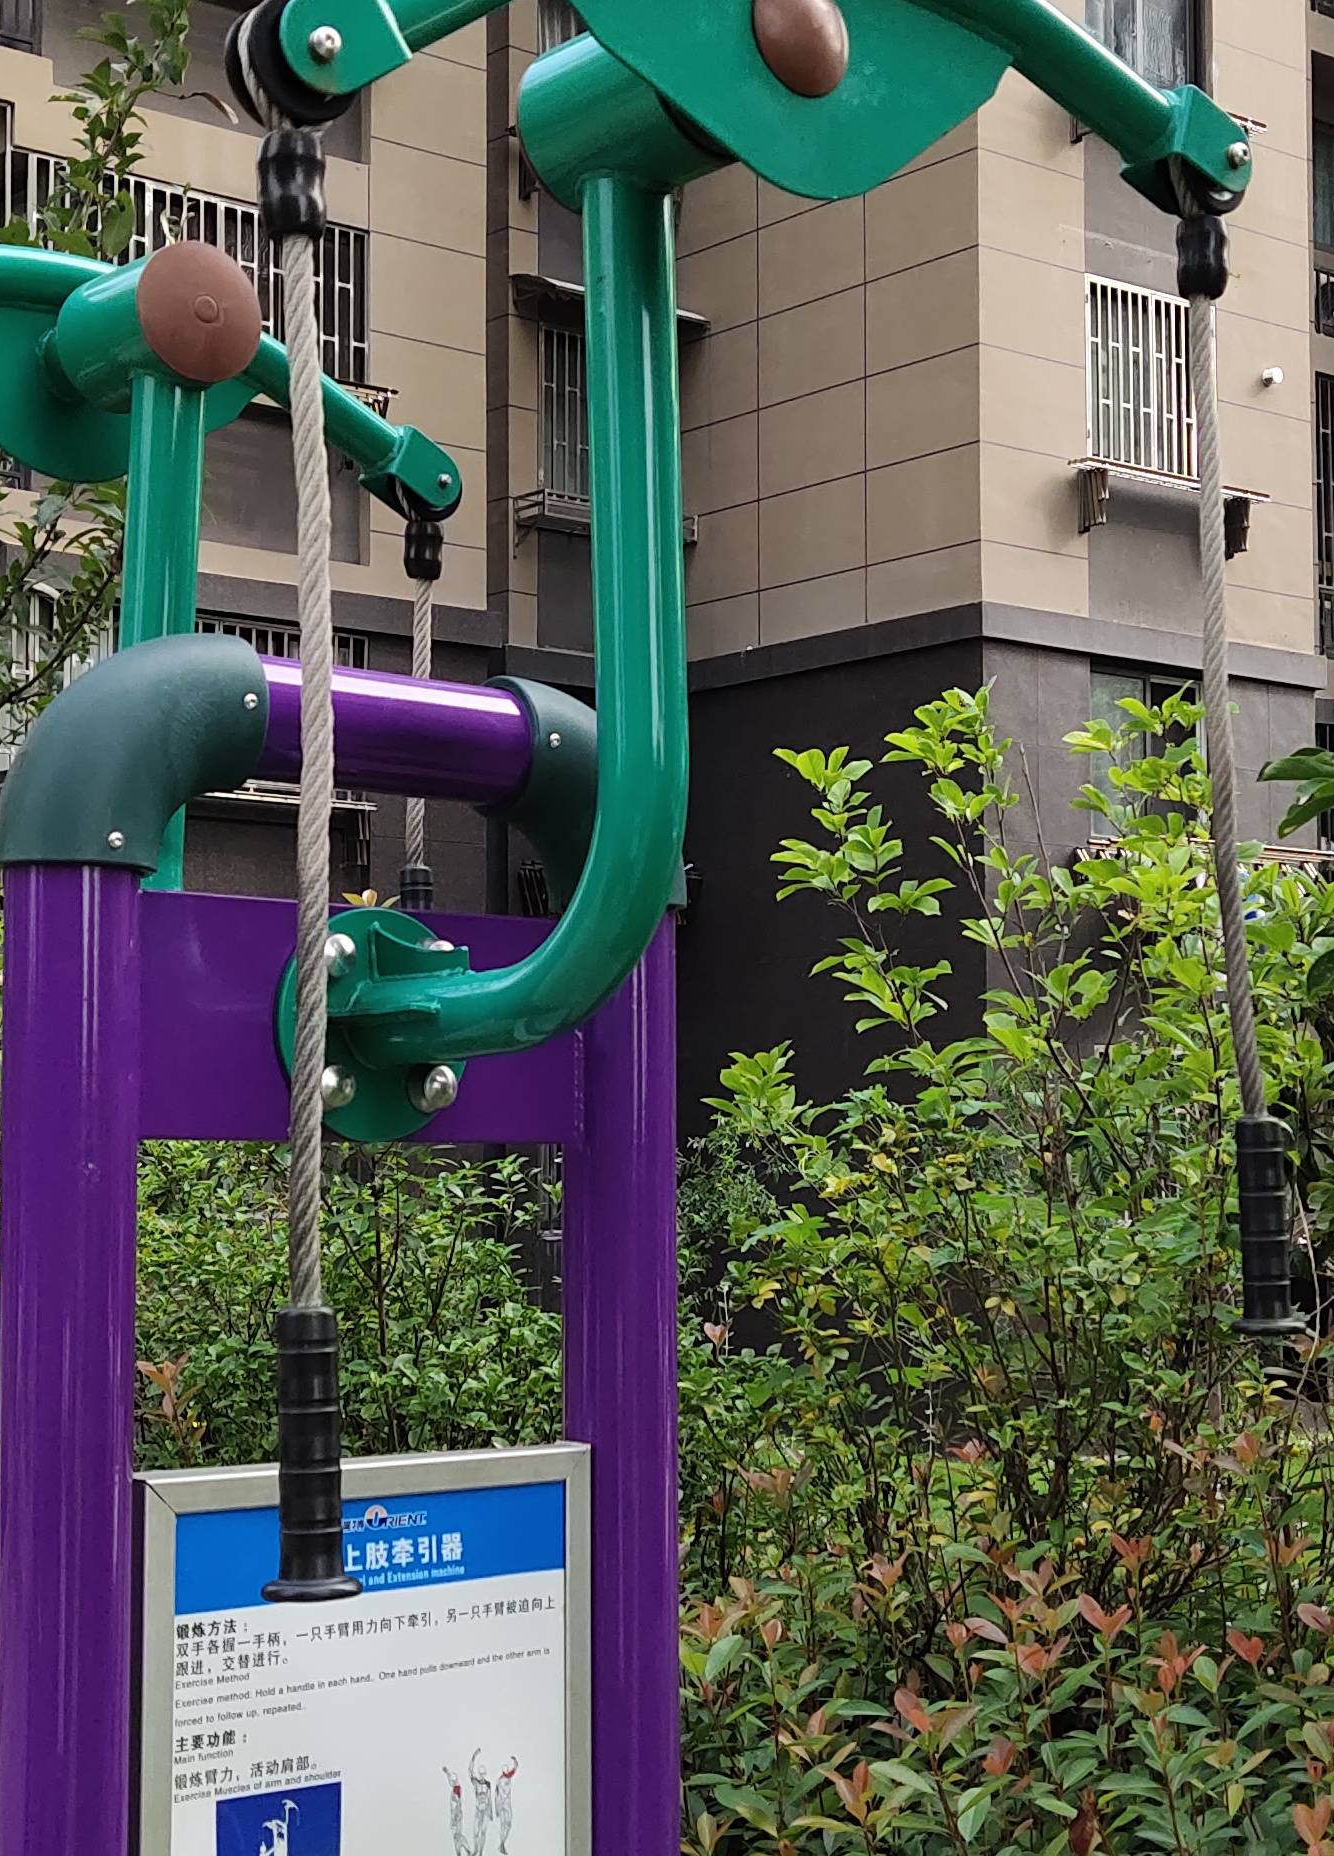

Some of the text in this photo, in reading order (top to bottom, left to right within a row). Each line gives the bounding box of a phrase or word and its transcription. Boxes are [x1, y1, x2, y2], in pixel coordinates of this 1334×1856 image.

[344, 1532, 463, 1572] 上肢牵引器
[368, 1572, 385, 1586] and
[387, 1567, 429, 1584] Extension
[431, 1563, 465, 1578] machine
[175, 1696, 214, 1709] Exercise
[255, 1687, 276, 1698] Hold
[286, 1682, 315, 1694] handle
[317, 1680, 325, 1690] in
[327, 1677, 347, 1688] each
[378, 1671, 396, 1681] One
[398, 1667, 418, 1678] hand
[477, 1654, 491, 1665] and
[492, 1651, 503, 1662] the
[505, 1650, 524, 1661] other
[526, 1647, 542, 1657] arm
[543, 1647, 551, 1656] is
[175, 1673, 250, 1690] Exercise Method
[175, 1715, 203, 1728] forced
[205, 1714, 215, 1724] to
[217, 1711, 243, 1722] follow
[174, 1749, 234, 1766] Main function
[174, 1790, 212, 1804] Exercise
[253, 1780, 263, 1790] of
[265, 1778, 283, 1788] arm
[285, 1774, 302, 1785] and
